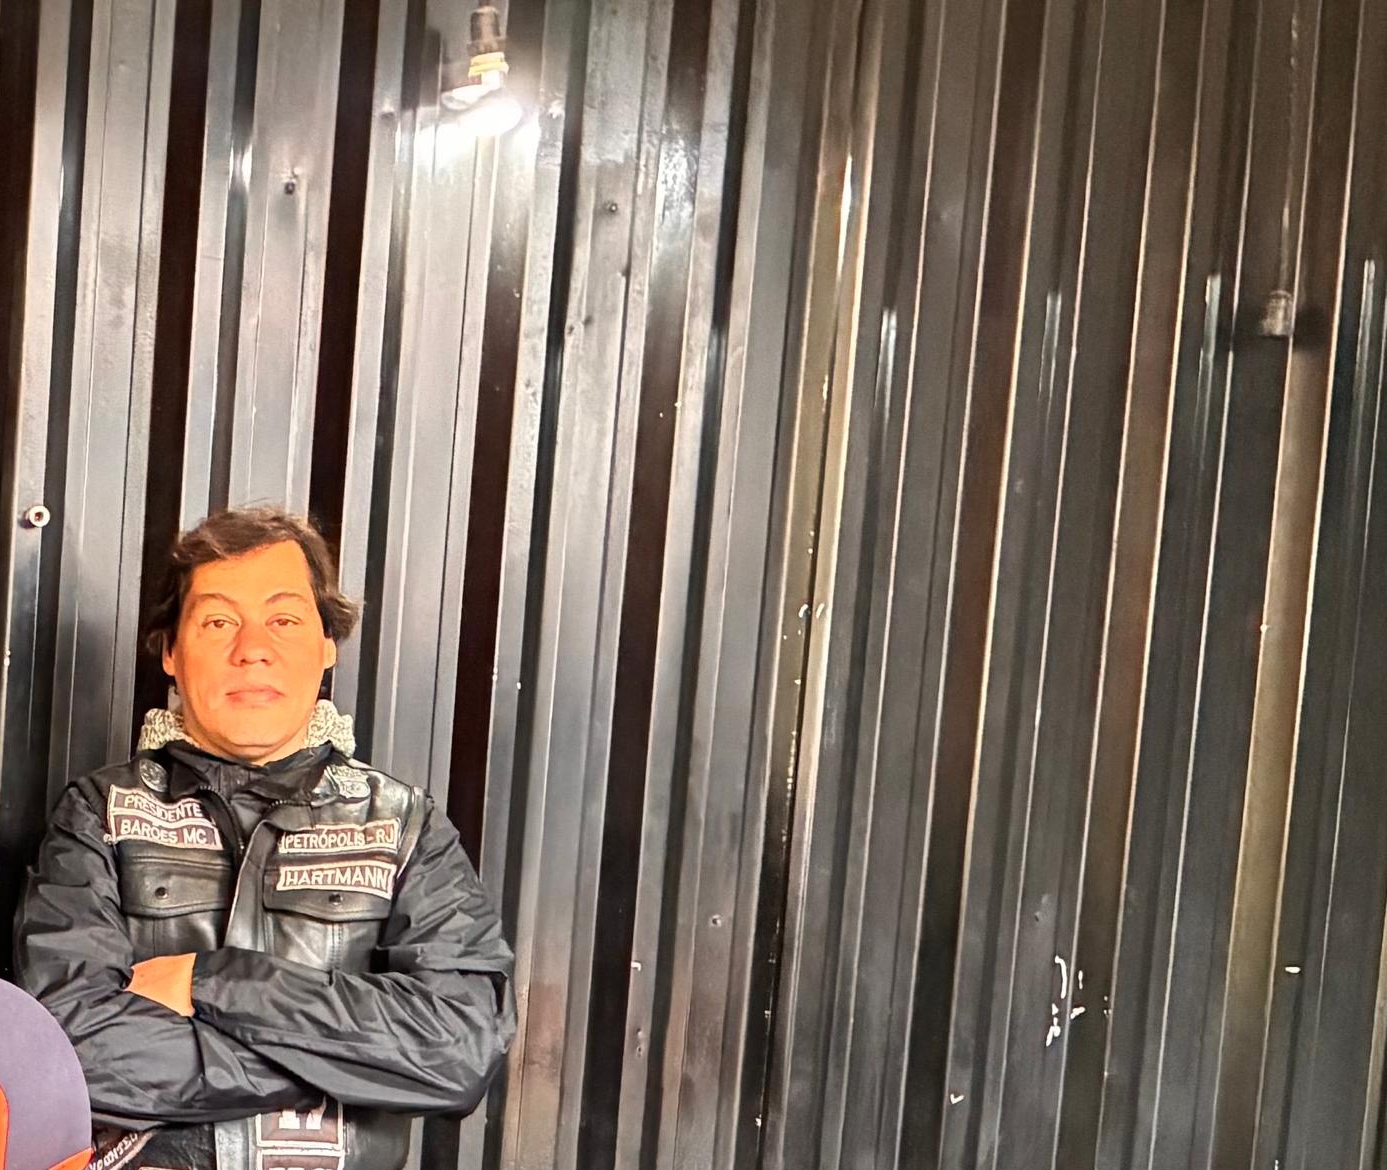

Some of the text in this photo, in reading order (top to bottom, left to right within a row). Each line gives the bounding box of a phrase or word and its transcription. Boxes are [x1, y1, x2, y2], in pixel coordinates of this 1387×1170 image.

[124, 795, 203, 820] PRESIDENTE
[183, 828, 206, 844] MC
[286, 866, 388, 890] HARTMANN
